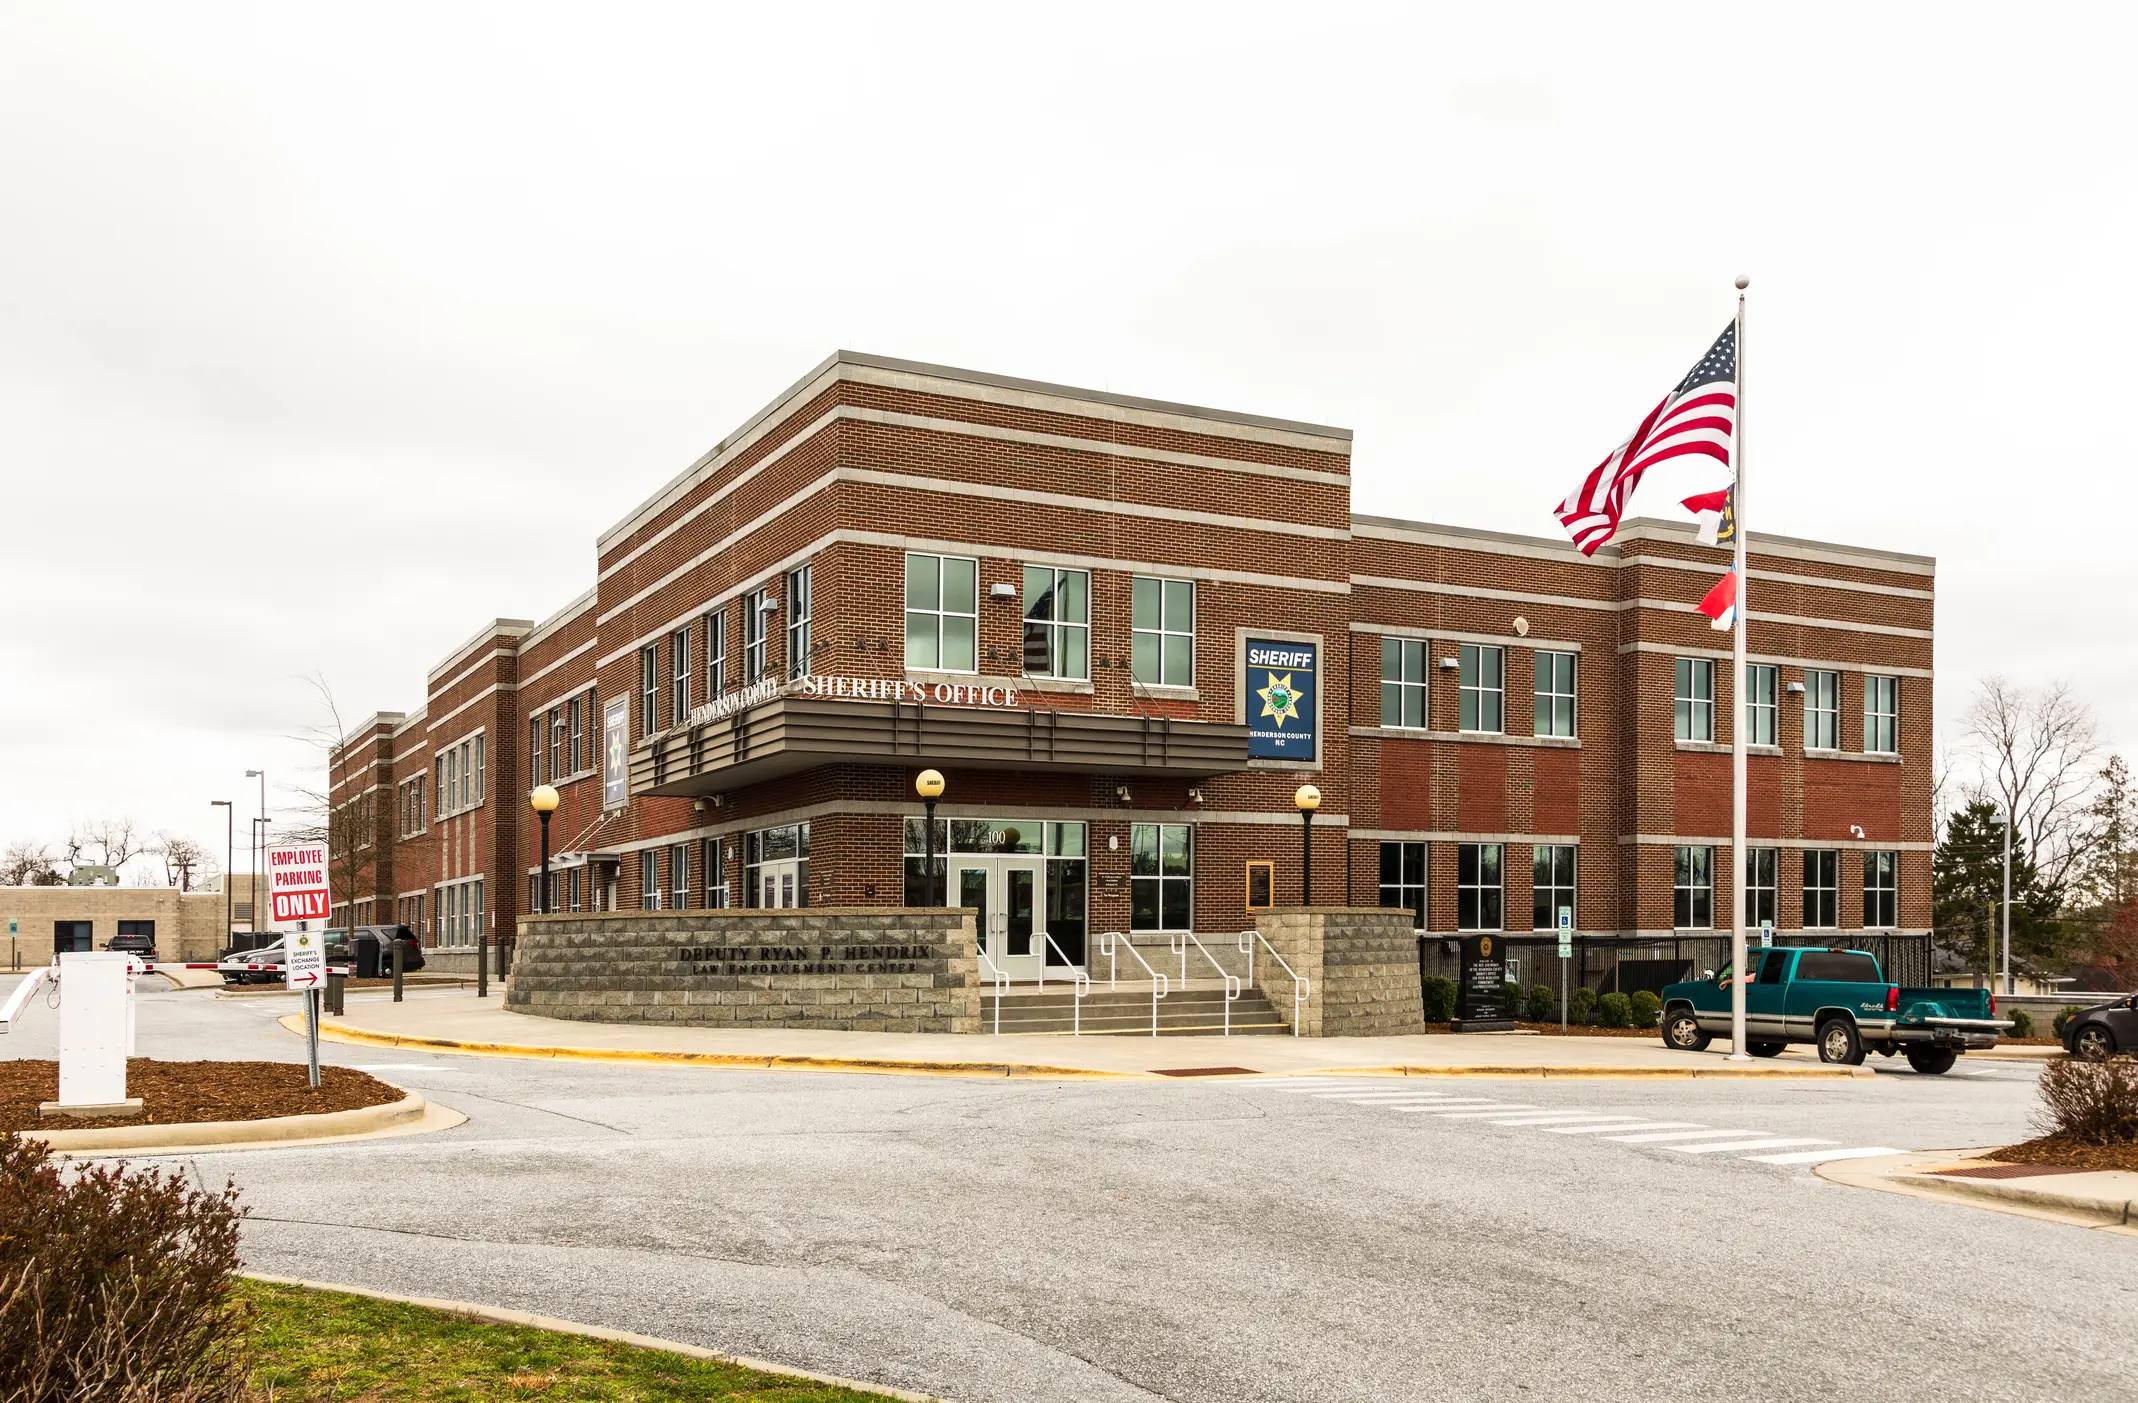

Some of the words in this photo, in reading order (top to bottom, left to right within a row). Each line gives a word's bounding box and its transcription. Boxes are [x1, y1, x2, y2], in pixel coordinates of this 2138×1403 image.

[1249, 649, 1312, 667] SHERIFF
[803, 674, 926, 701] SHERIFF'S
[934, 683, 1019, 707] OFFICE
[690, 692, 739, 726] HENDERSON
[741, 675, 779, 708] COUNTY
[988, 831, 1006, 844] 100
[271, 850, 323, 866] EMPLOYEE
[275, 870, 323, 886] PARKING
[276, 893, 325, 917] ONLY
[680, 948, 750, 961] DEPUTY
[760, 947, 807, 960] RYAN
[844, 946, 930, 960] HENDRIX
[692, 965, 719, 974] LAW
[729, 964, 847, 974] ENFORCEMENT
[856, 963, 917, 973] CENTER
